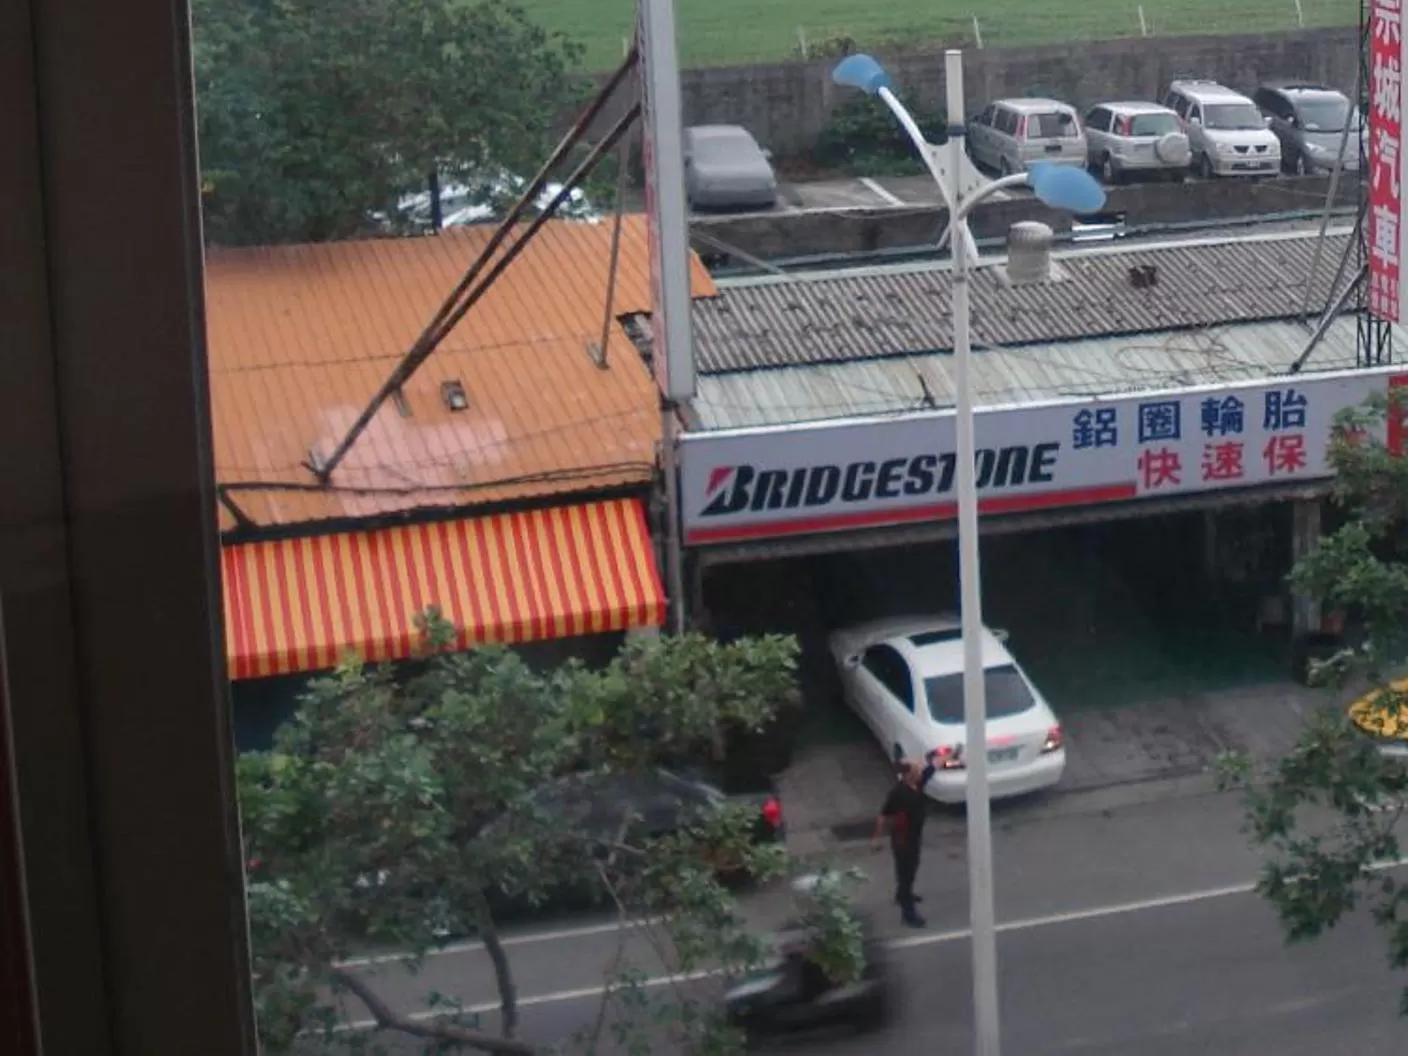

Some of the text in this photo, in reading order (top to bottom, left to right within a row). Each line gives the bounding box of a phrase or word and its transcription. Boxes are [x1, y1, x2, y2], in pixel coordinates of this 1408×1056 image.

[1072, 389, 1307, 449] 鋁圈輪胎
[699, 442, 1061, 516] BRIDGESTONE
[1137, 428, 1366, 489] 快速保
